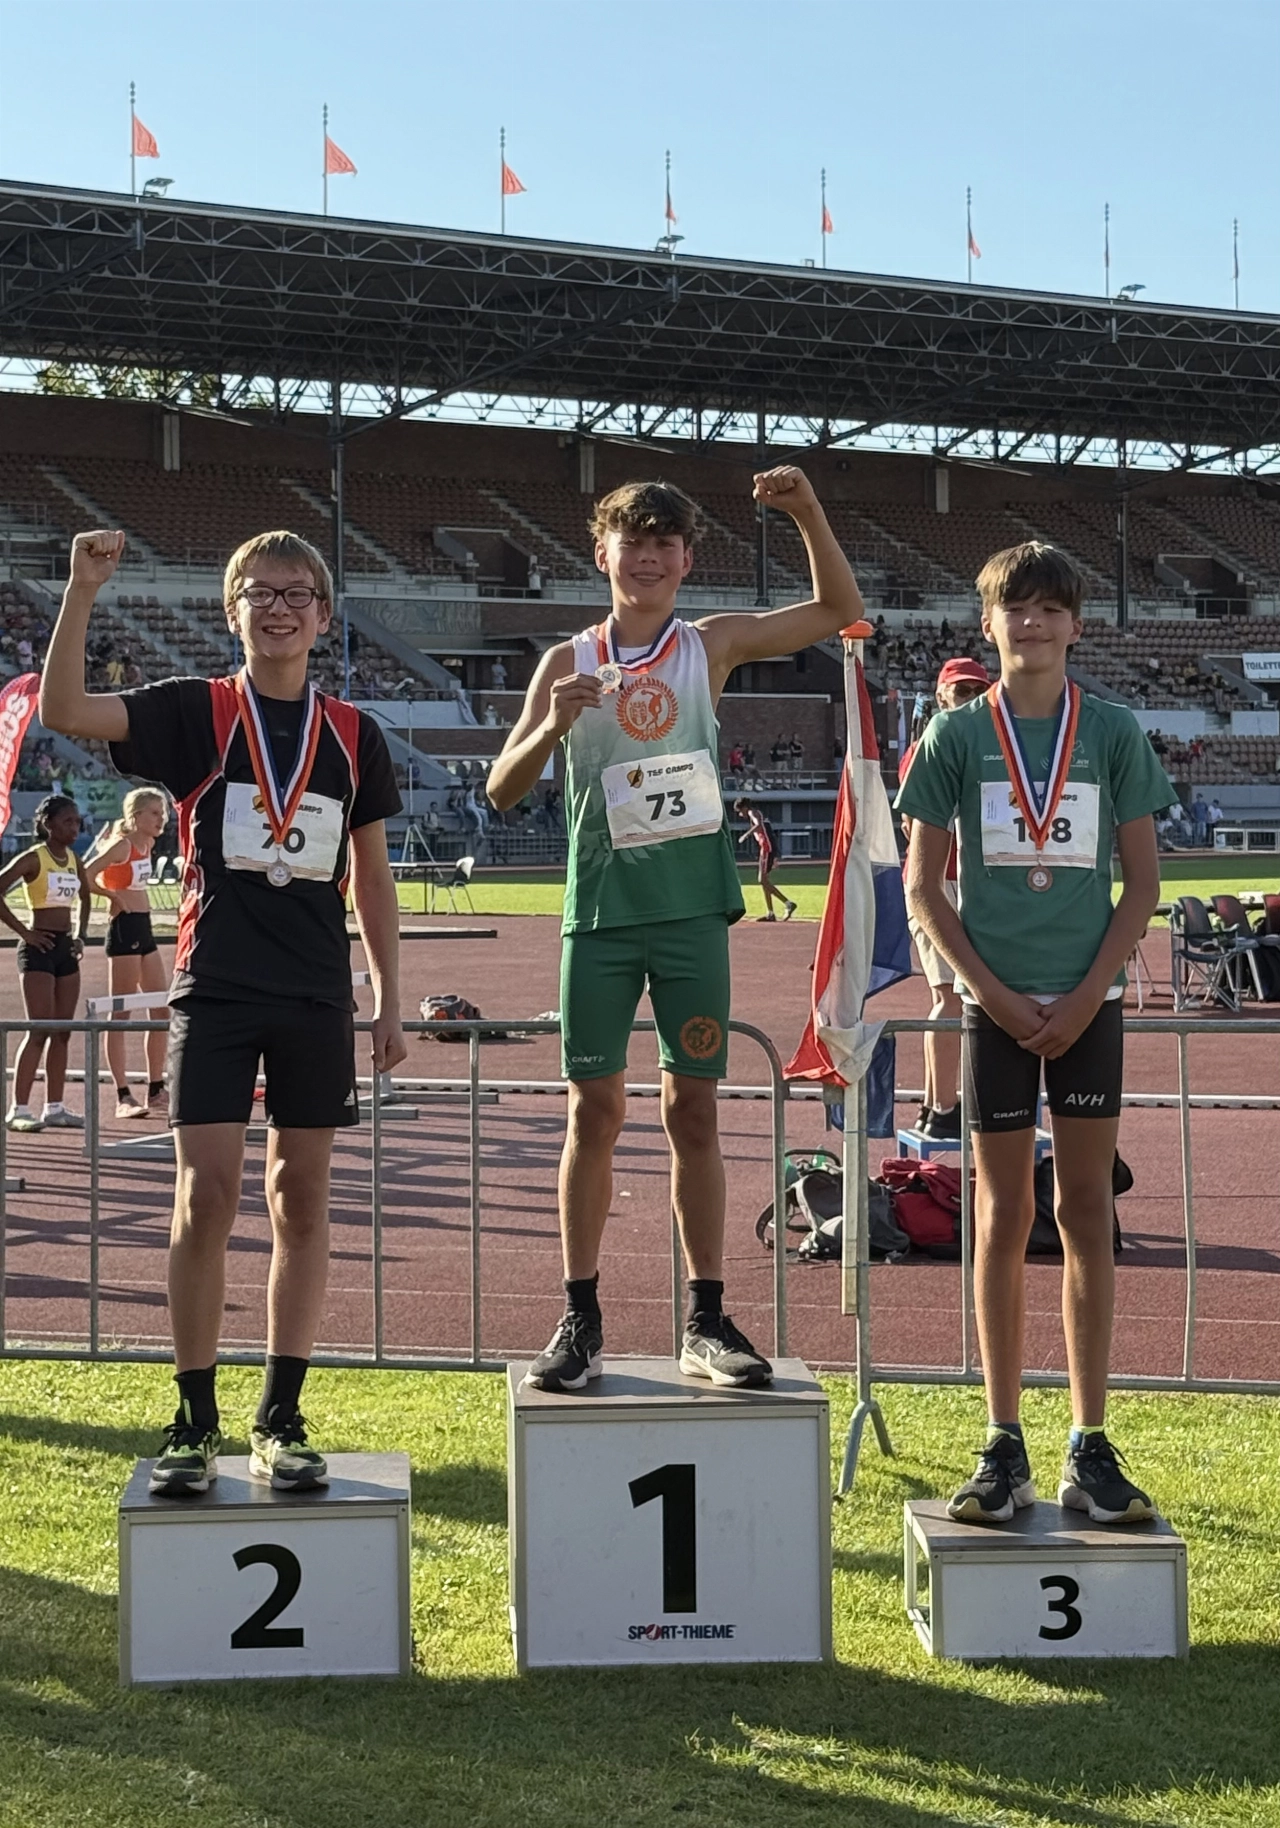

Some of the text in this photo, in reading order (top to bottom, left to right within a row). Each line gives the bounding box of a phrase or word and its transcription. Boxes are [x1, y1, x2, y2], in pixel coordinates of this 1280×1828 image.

[297, 804, 323, 815] AMPS
[645, 789, 687, 821] 73
[261, 822, 306, 854] 70
[1012, 817, 1072, 843] 18
[57, 886, 76, 898] 707
[571, 1055, 600, 1063] CRAFT
[1064, 1093, 1105, 1106] AVH
[992, 1109, 1024, 1119] CRAFT
[627, 1463, 697, 1614] 1
[230, 1543, 304, 1649] 2
[1038, 1574, 1083, 1641] 3
[627, 1623, 737, 1641] SPORT-THIEME
